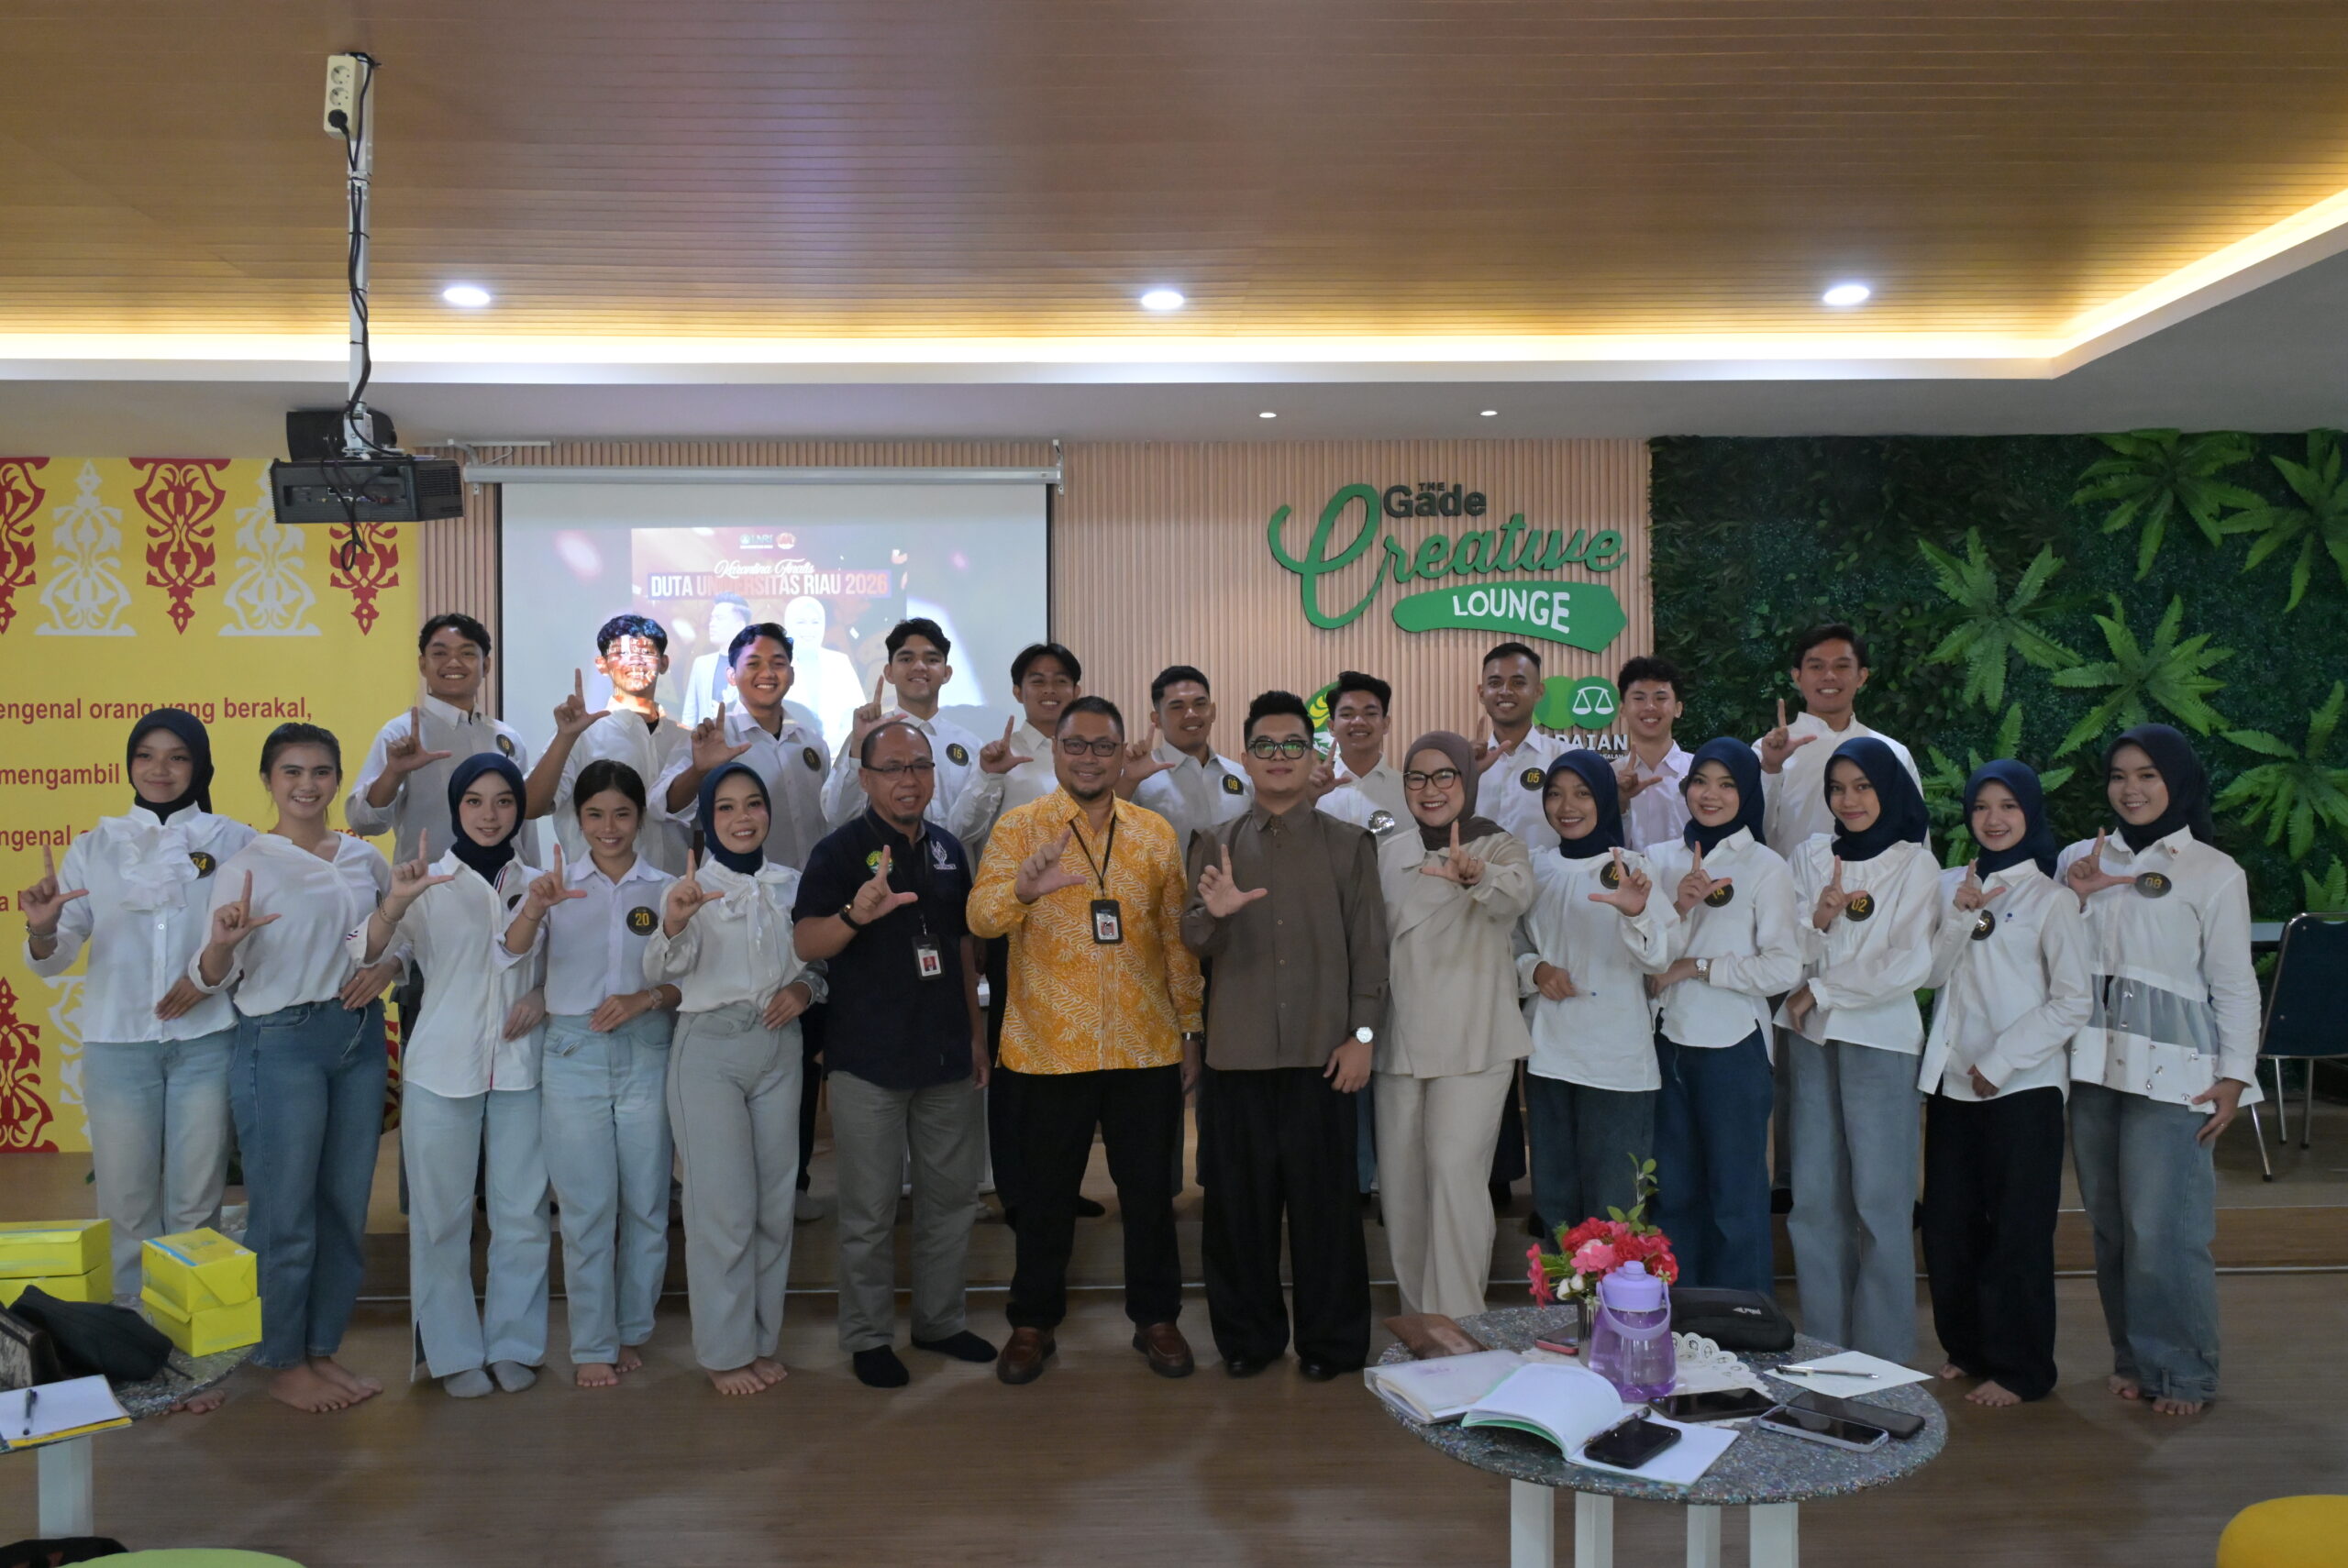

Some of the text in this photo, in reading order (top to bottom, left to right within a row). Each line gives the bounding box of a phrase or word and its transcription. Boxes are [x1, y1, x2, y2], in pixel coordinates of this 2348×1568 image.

[1418, 482, 1445, 491] THE
[1383, 484, 1487, 518] Gade
[1268, 483, 1628, 630] Creative
[714, 558, 814, 580] Karantina Finalis
[651, 575, 692, 596] DUTA
[804, 573, 841, 594] RIAU
[845, 572, 890, 593] 2026
[1453, 588, 1570, 634] LOUNGE
[224, 697, 313, 722] berakal,
[953, 747, 962, 759] 15
[0, 763, 119, 790] mengambil
[1227, 779, 1238, 790] 09
[1527, 772, 1540, 784] 05
[2145, 877, 2163, 889] 08
[1851, 898, 1867, 913] 02
[634, 912, 649, 926] 20
